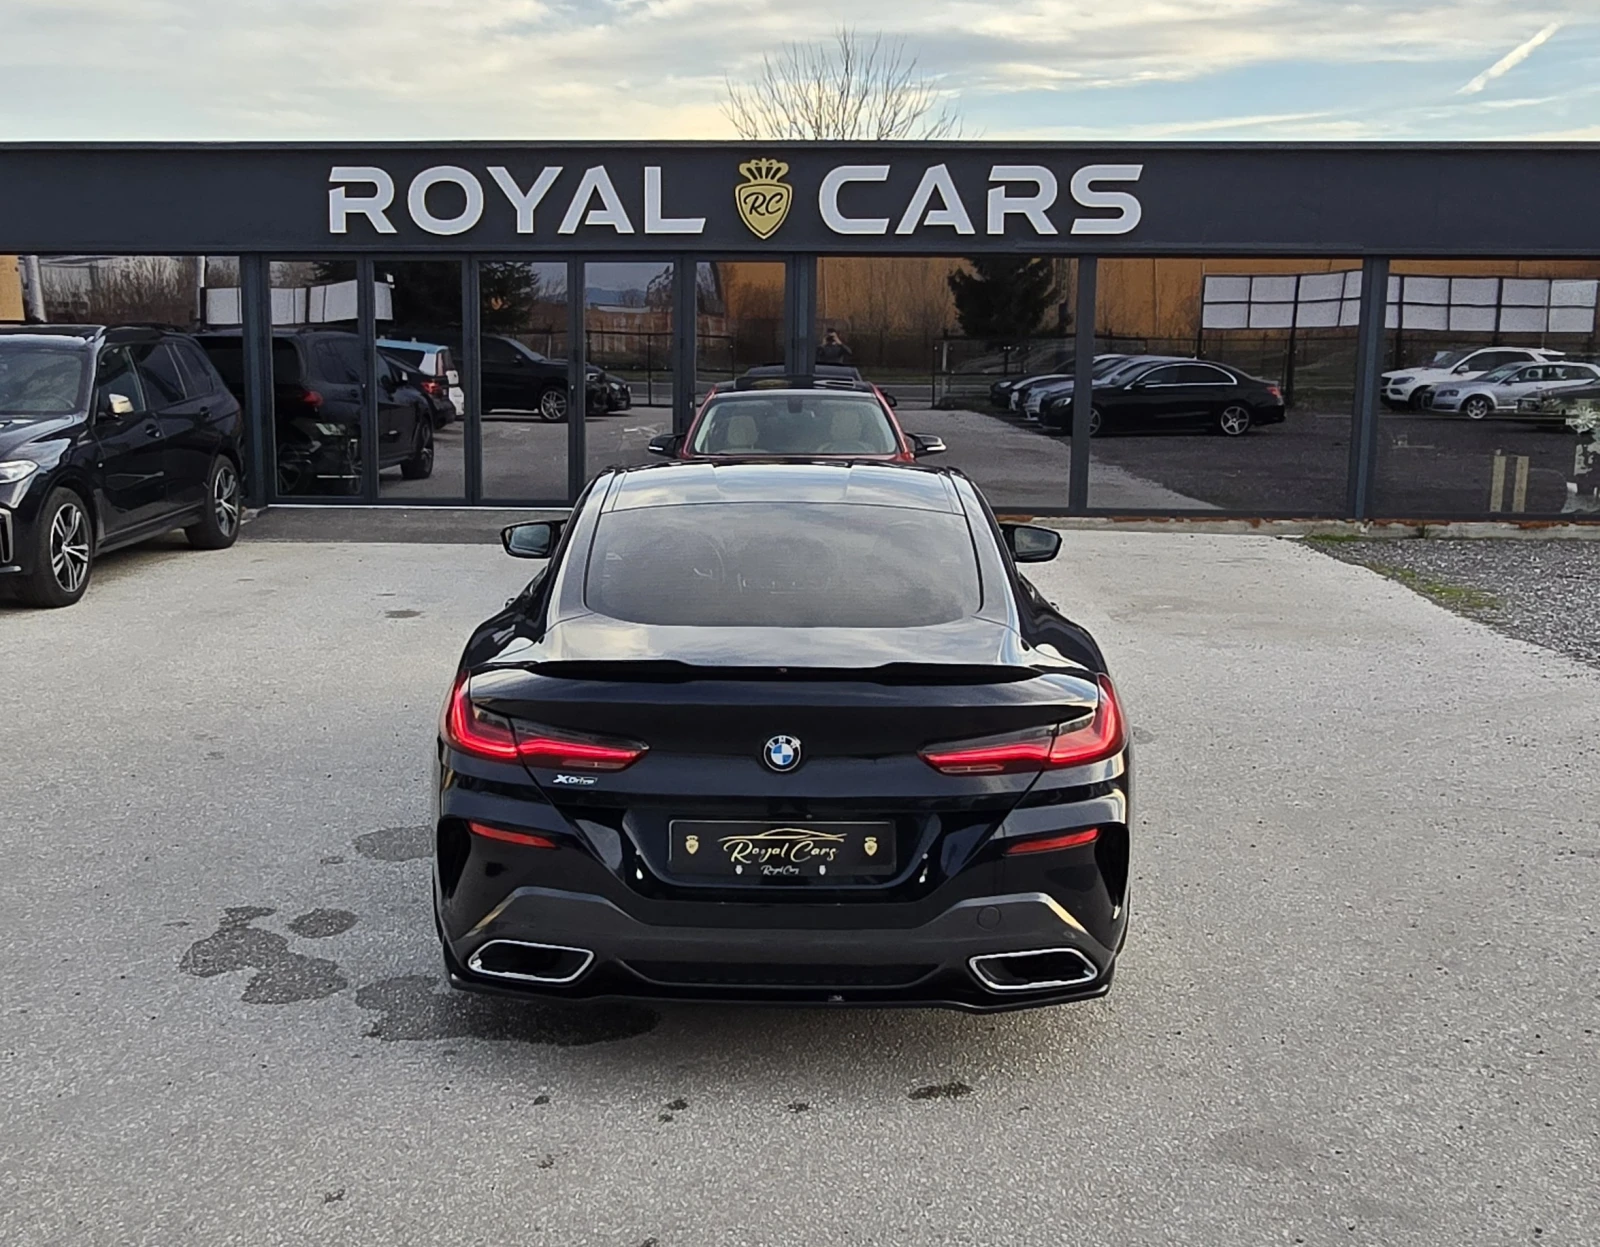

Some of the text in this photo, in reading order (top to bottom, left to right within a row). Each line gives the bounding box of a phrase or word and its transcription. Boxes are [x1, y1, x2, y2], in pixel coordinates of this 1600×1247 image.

[329, 163, 1144, 235] ROYAL CARS
[743, 191, 784, 216] RC
[723, 839, 838, 864] Royal Cars
